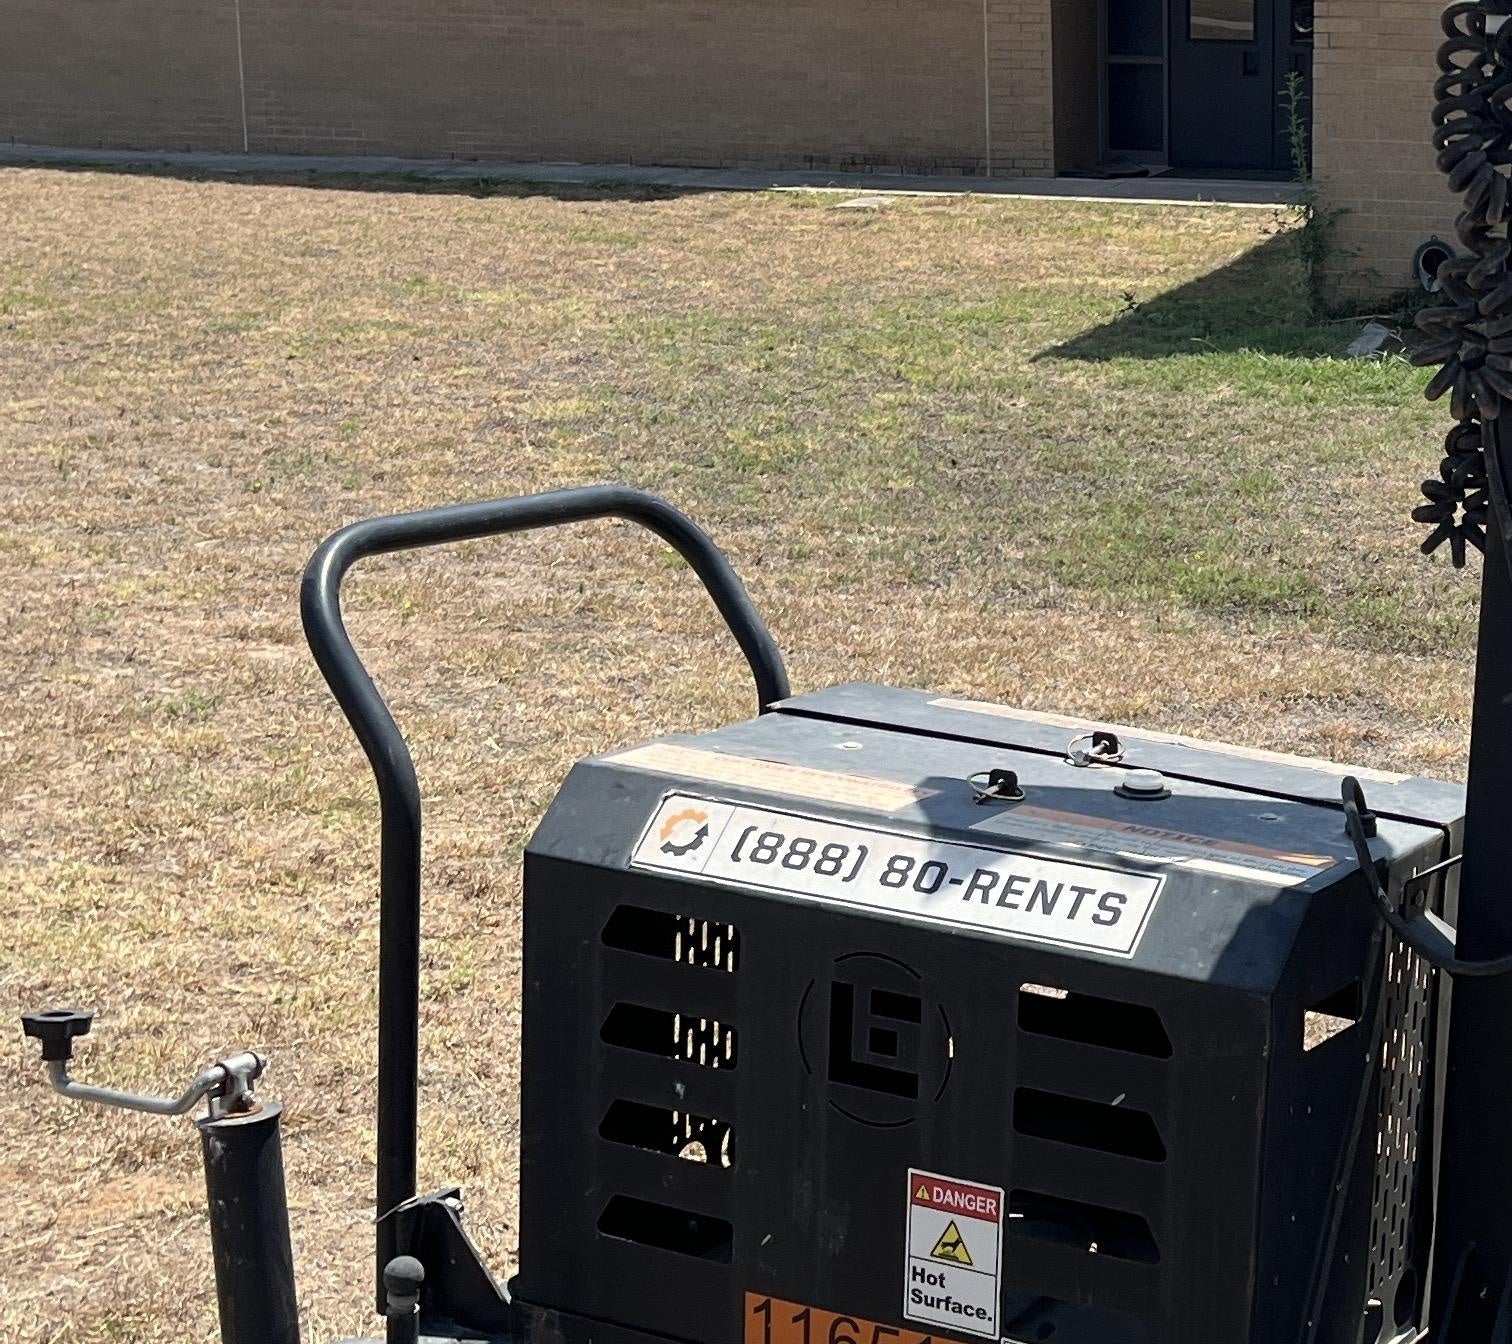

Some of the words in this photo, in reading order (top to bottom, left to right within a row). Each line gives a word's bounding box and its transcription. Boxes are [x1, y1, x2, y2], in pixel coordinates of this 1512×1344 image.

[730, 825, 870, 883] (888)
[879, 855, 1129, 928] 80-RENTS
[932, 1185, 998, 1216] DANGER
[911, 1265, 947, 1289] Hot
[910, 1287, 994, 1323] Surface.
